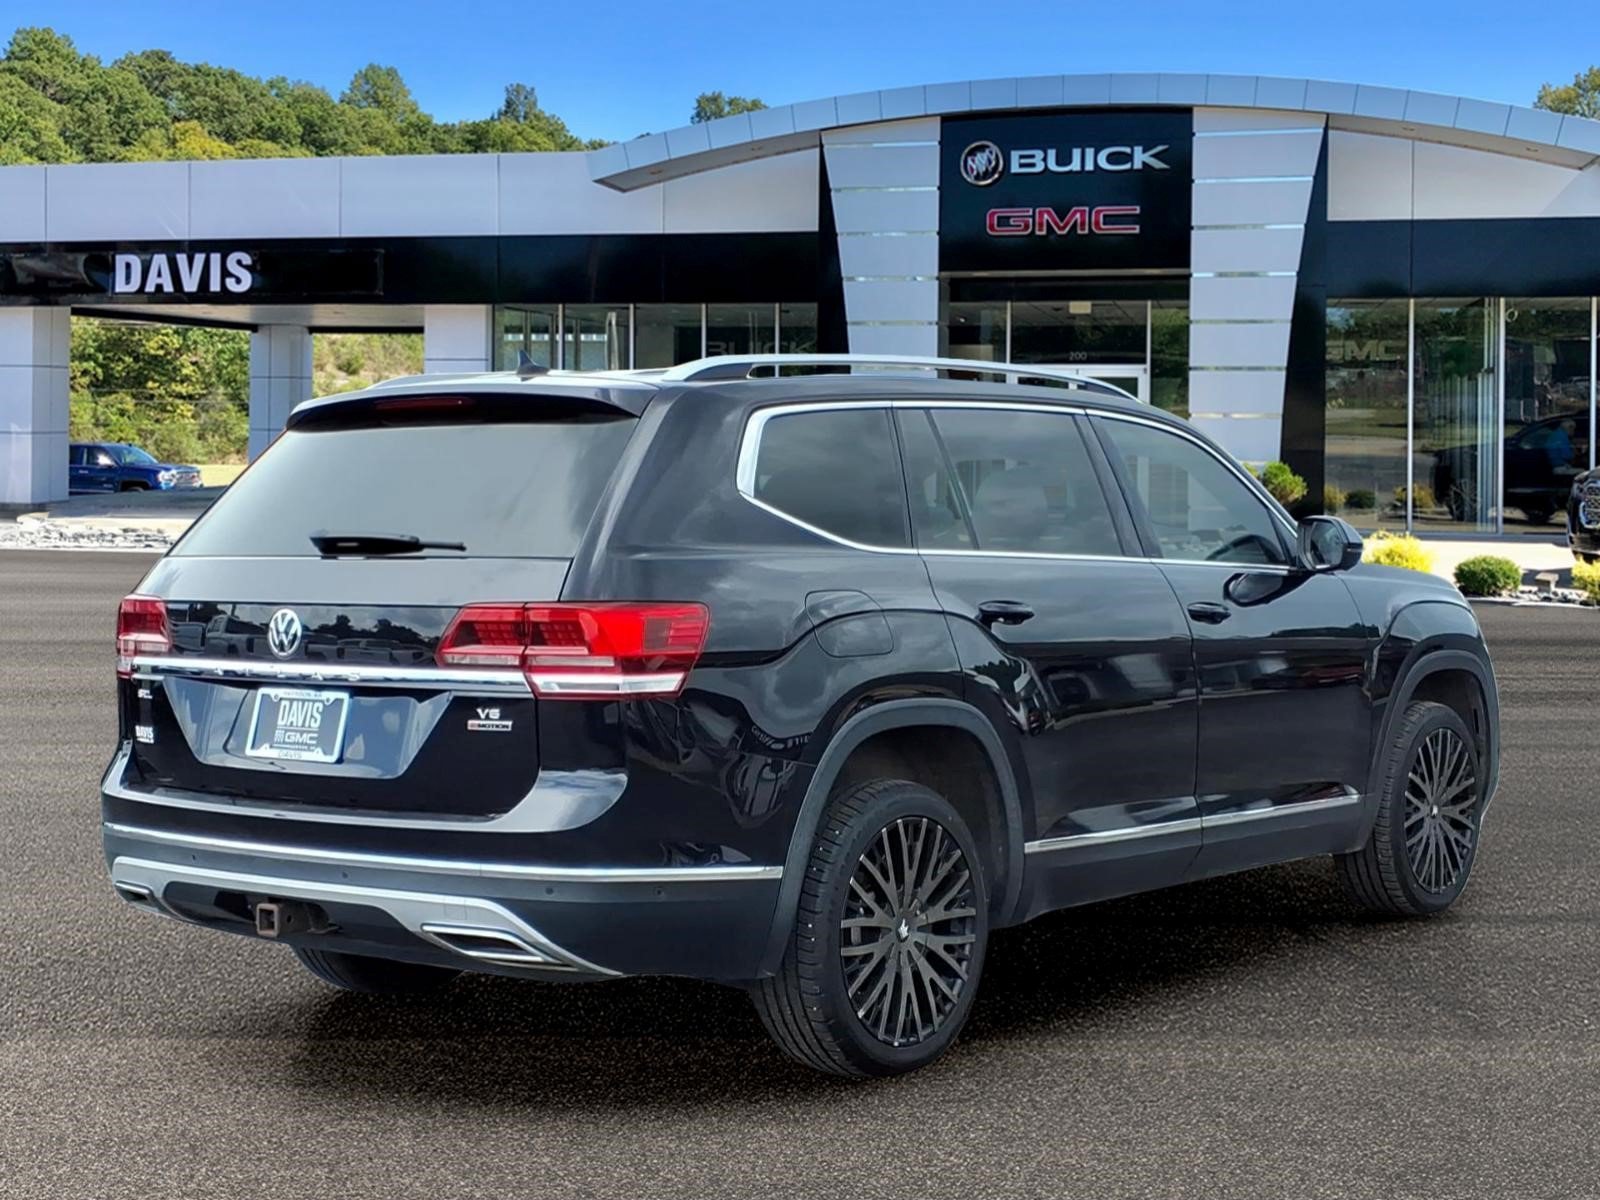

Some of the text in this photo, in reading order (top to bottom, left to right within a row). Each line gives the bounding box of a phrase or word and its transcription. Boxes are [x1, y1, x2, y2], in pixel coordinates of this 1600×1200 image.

[1010, 145, 1170, 174] BUICK
[986, 205, 1141, 236] GMC
[114, 251, 252, 293] DAVIS
[1069, 351, 1088, 361] 200
[277, 699, 324, 728] DAVIS
[476, 708, 500, 719] V6
[284, 731, 319, 744] GMC
